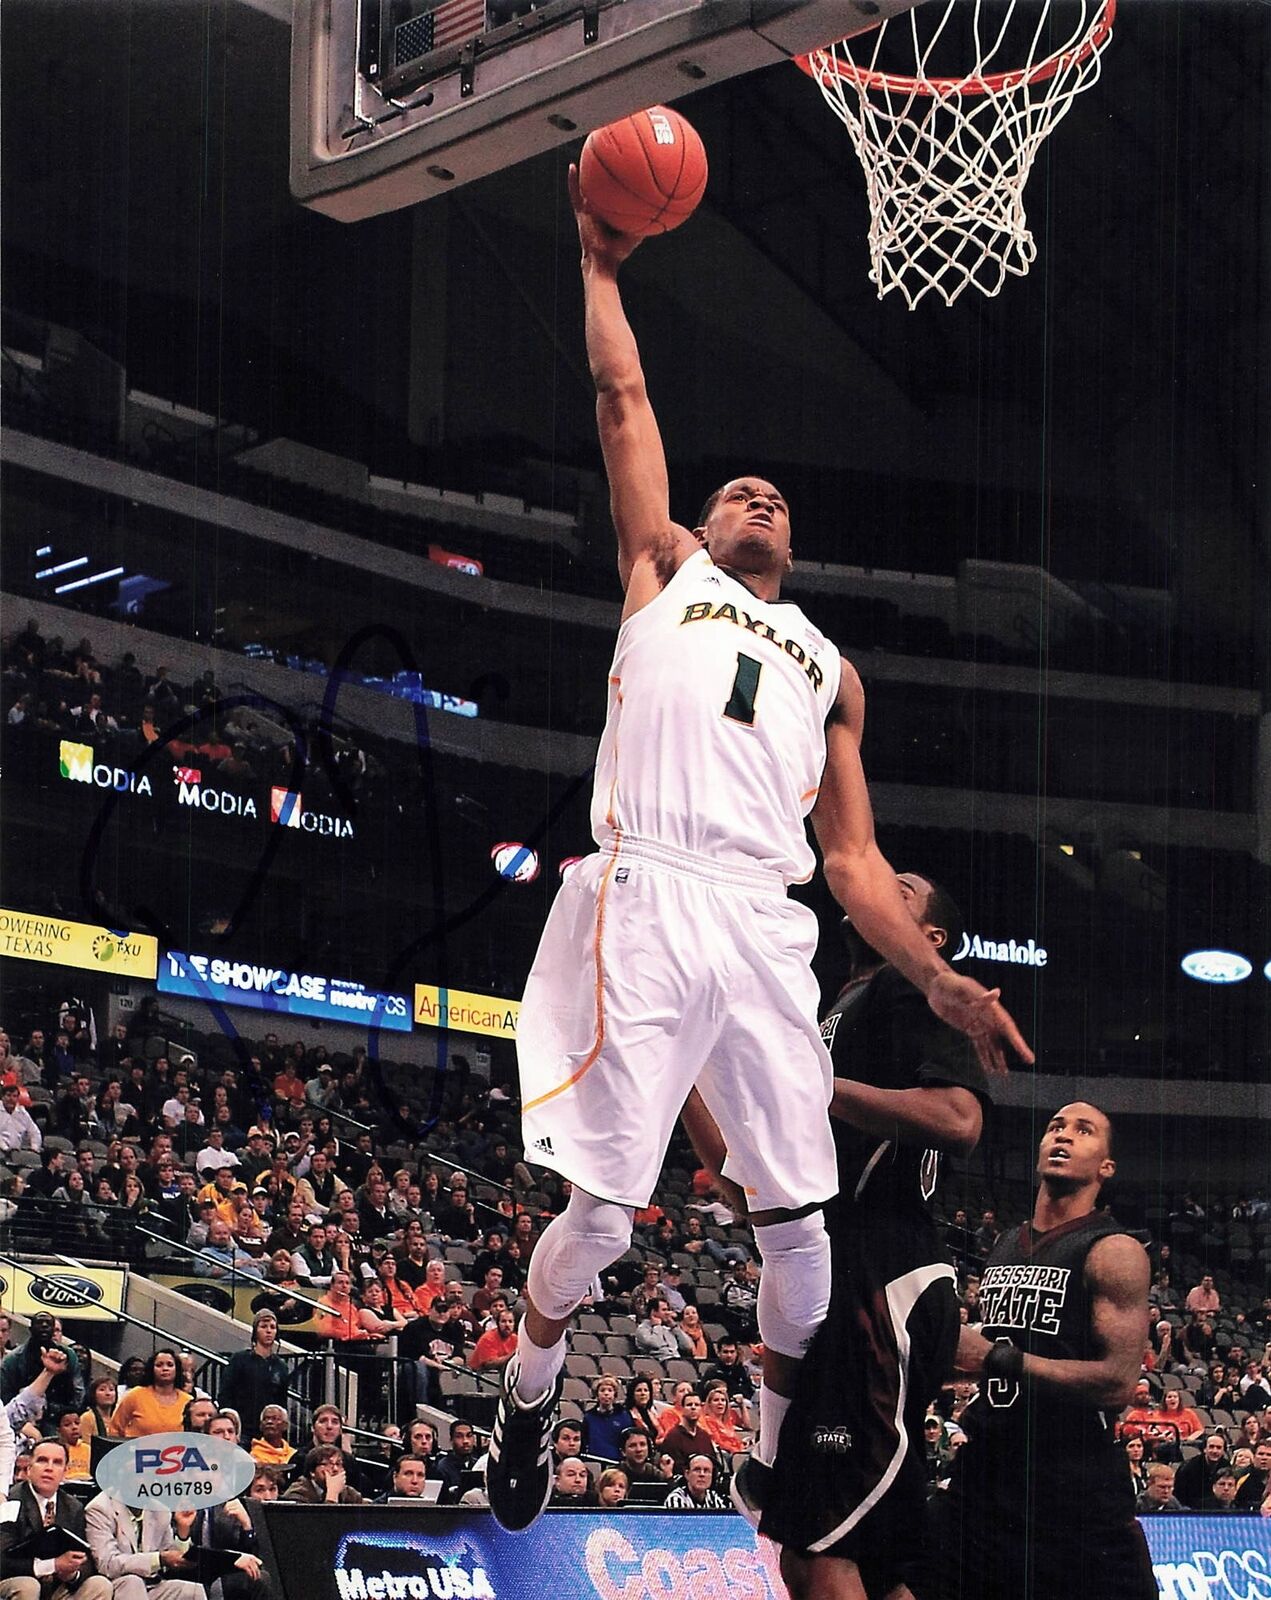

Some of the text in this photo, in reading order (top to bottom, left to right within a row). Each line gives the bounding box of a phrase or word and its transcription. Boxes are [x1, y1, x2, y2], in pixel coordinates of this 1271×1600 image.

[679, 602, 823, 694] BAYLOR
[722, 651, 763, 727] 1
[68, 757, 152, 797] MODIA
[178, 780, 257, 820] MODIA
[5, 935, 54, 957] TEXAS
[969, 933, 1048, 967] Anatole
[210, 958, 327, 1002] SHOWCASE
[816, 1433, 846, 1444] STATE
[334, 1568, 496, 1600] Metro USA
